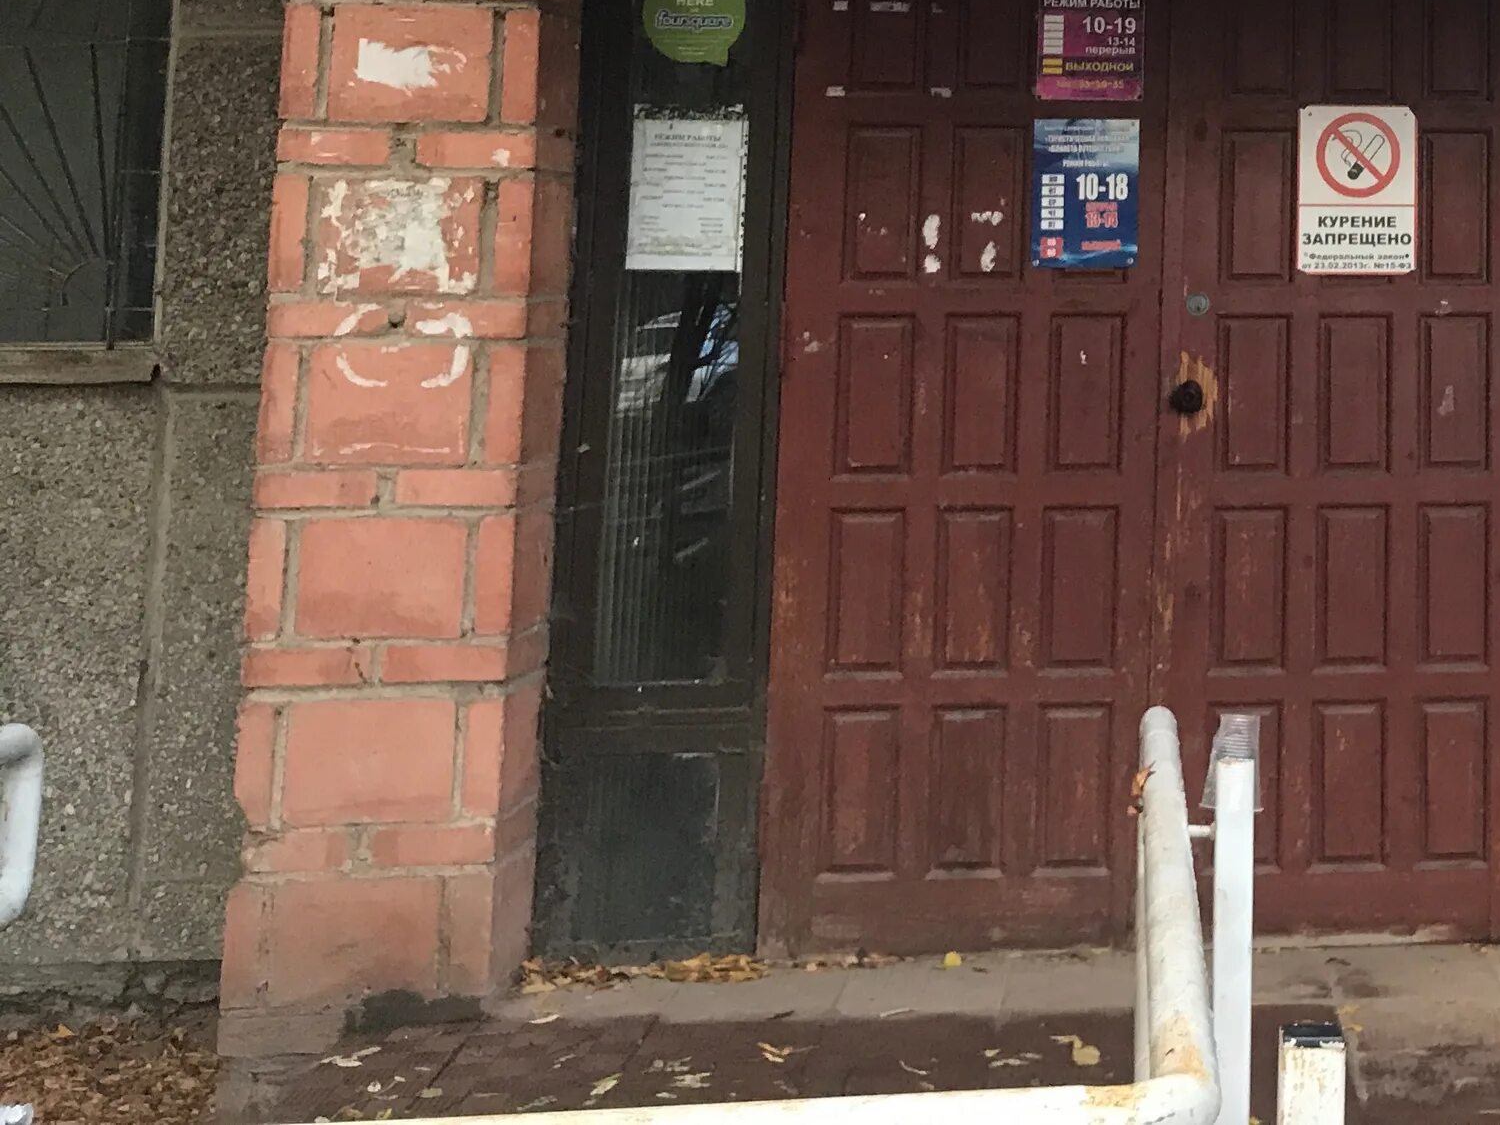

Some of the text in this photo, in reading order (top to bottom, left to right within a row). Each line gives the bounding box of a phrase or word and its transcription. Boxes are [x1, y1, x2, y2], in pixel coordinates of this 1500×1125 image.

[657, 10, 732, 32] foursquare
[1082, 16, 1136, 34] 10-19
[1107, 36, 1136, 46] 13-14
[1085, 46, 1136, 55] перерыв
[1065, 60, 1134, 72] ВЫХОДНОЙ
[1076, 173, 1129, 200] 10-18
[1318, 216, 1397, 228] КУРЕНИЕ
[1303, 233, 1411, 247] ЗАПРЕЩЕНО
